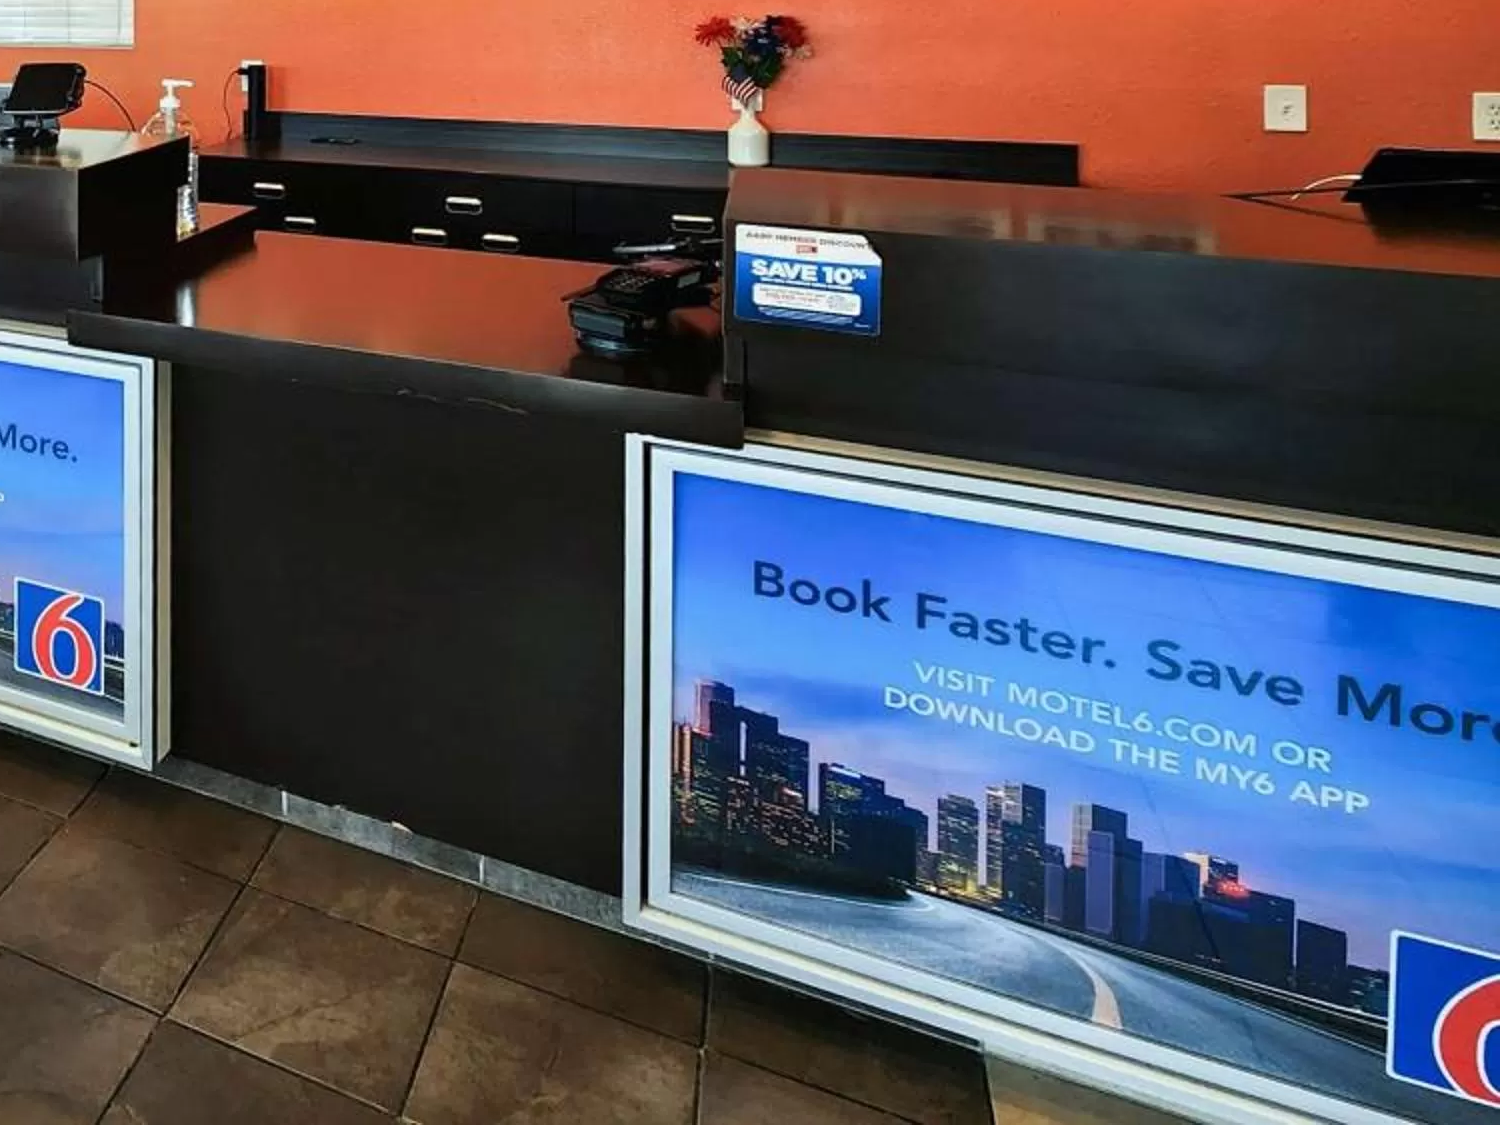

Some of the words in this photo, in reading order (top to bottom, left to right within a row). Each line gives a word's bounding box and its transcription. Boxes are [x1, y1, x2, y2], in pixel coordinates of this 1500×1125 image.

[752, 259, 819, 283] SAVE
[822, 266, 868, 286] 10%
[32, 592, 97, 689] 6
[753, 559, 893, 623] Book
[916, 591, 1117, 669] Faster.
[1145, 639, 1304, 706] Save
[1337, 674, 1500, 744] Mor
[883, 686, 1096, 754] DOWNLOAD
[1108, 738, 1182, 775] THE
[1195, 757, 1276, 796] MY6
[1288, 779, 1371, 815] APP
[914, 661, 996, 697] VISIT
[1007, 682, 1257, 759] MOTEL6.COM
[1271, 740, 1332, 773] OR
